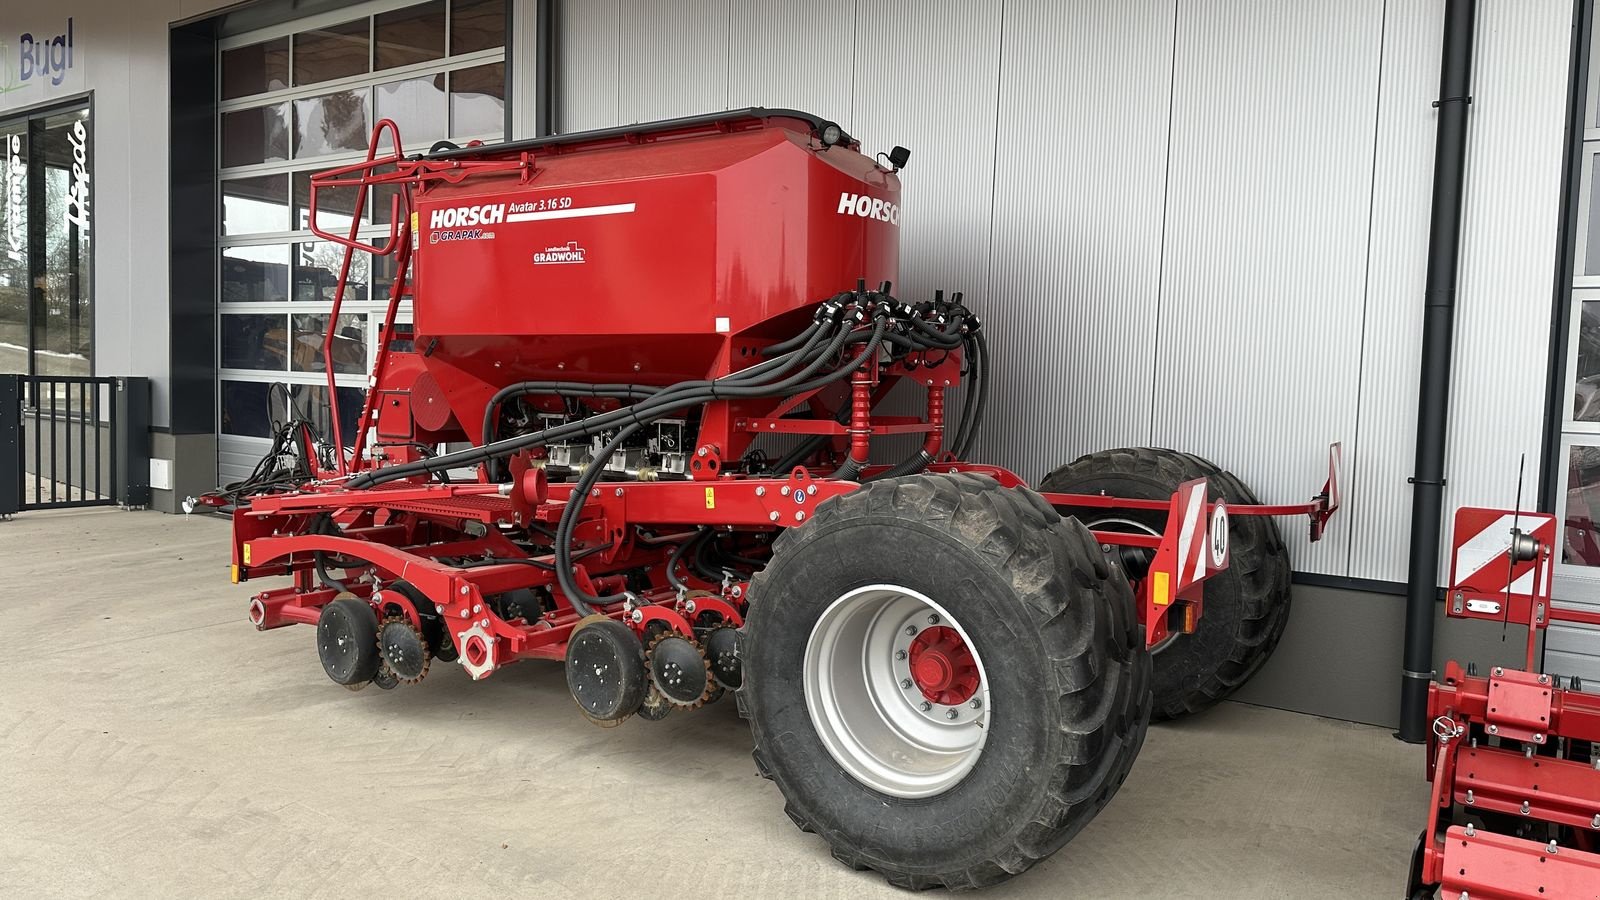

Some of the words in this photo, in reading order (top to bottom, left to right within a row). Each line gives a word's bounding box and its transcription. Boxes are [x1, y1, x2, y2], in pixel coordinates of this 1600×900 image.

[20, 16, 73, 86] Bugl
[7, 133, 27, 261] Krampe
[430, 203, 505, 229] HORSCH
[509, 202, 537, 213] Avatar
[539, 199, 557, 211] 3.16
[559, 197, 571, 208] SD
[837, 192, 900, 227] HORSCH
[533, 251, 584, 262] GRADWOHL
[1215, 516, 1224, 556] 40
